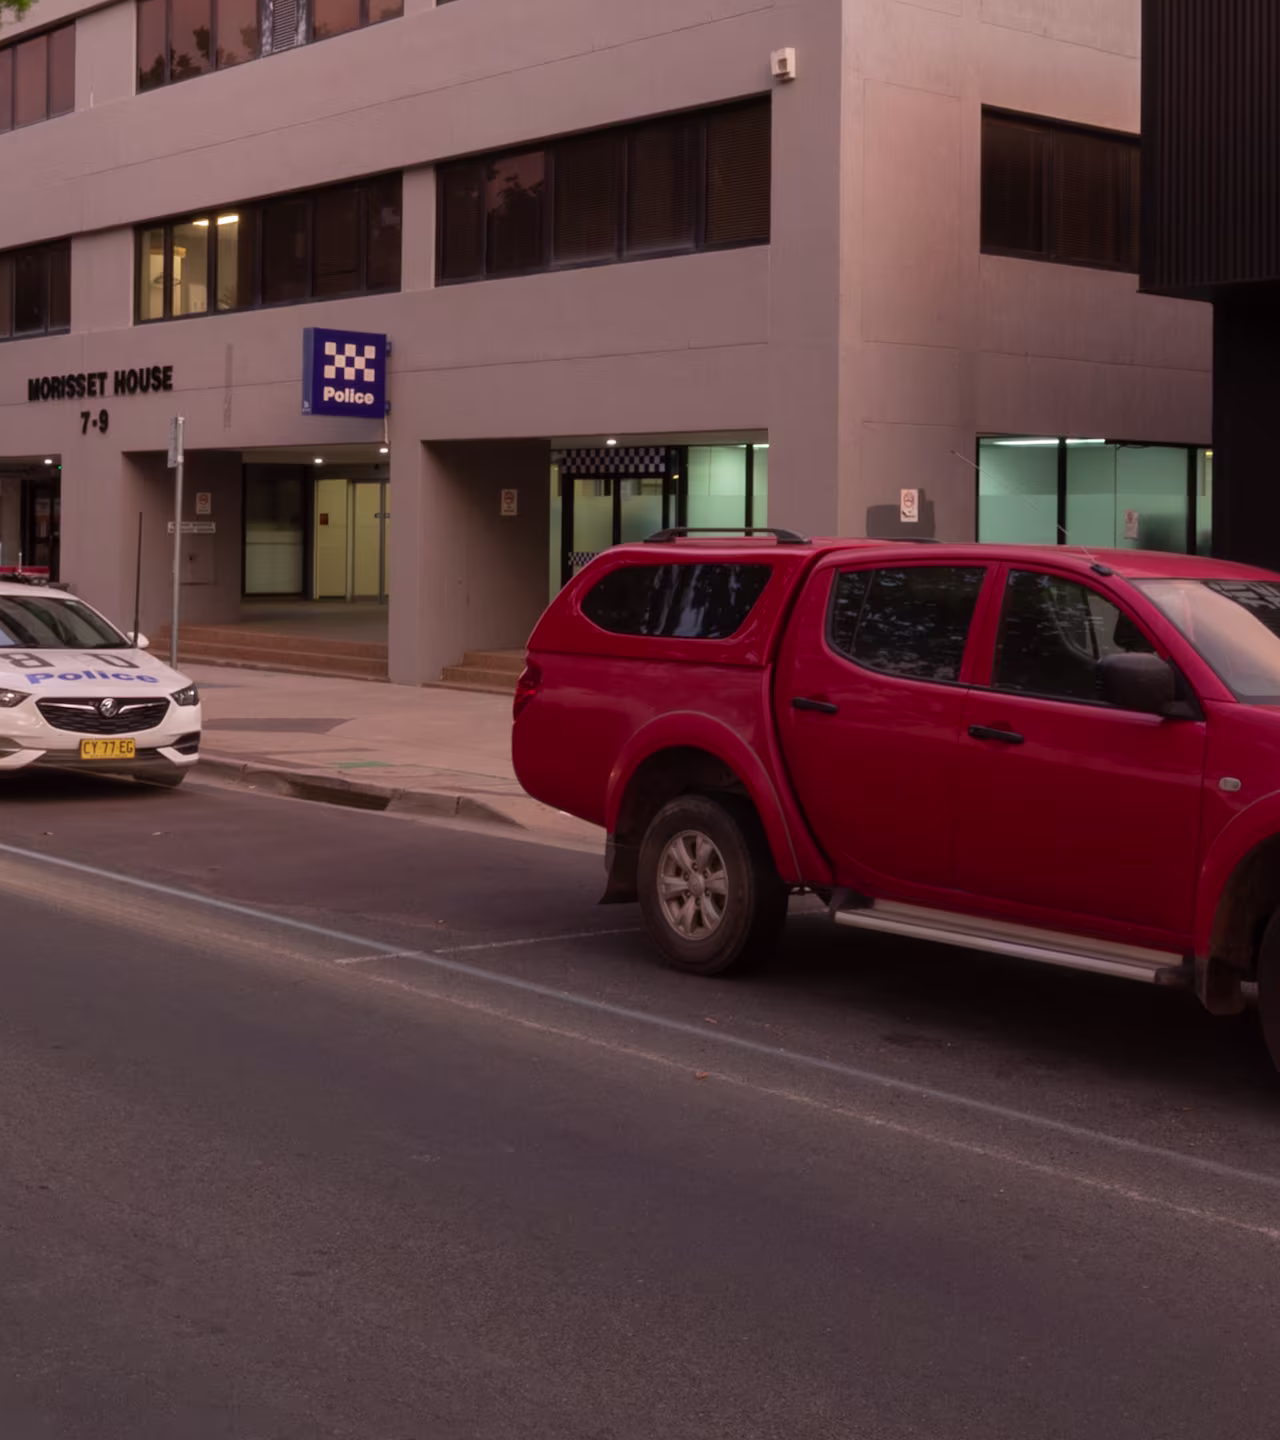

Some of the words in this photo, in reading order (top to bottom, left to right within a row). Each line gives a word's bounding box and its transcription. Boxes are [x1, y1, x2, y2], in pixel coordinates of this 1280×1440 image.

[28, 371, 108, 402] MORISSET
[114, 366, 173, 396] HOUSE
[323, 386, 375, 405] Police
[24, 670, 159, 685] Police
